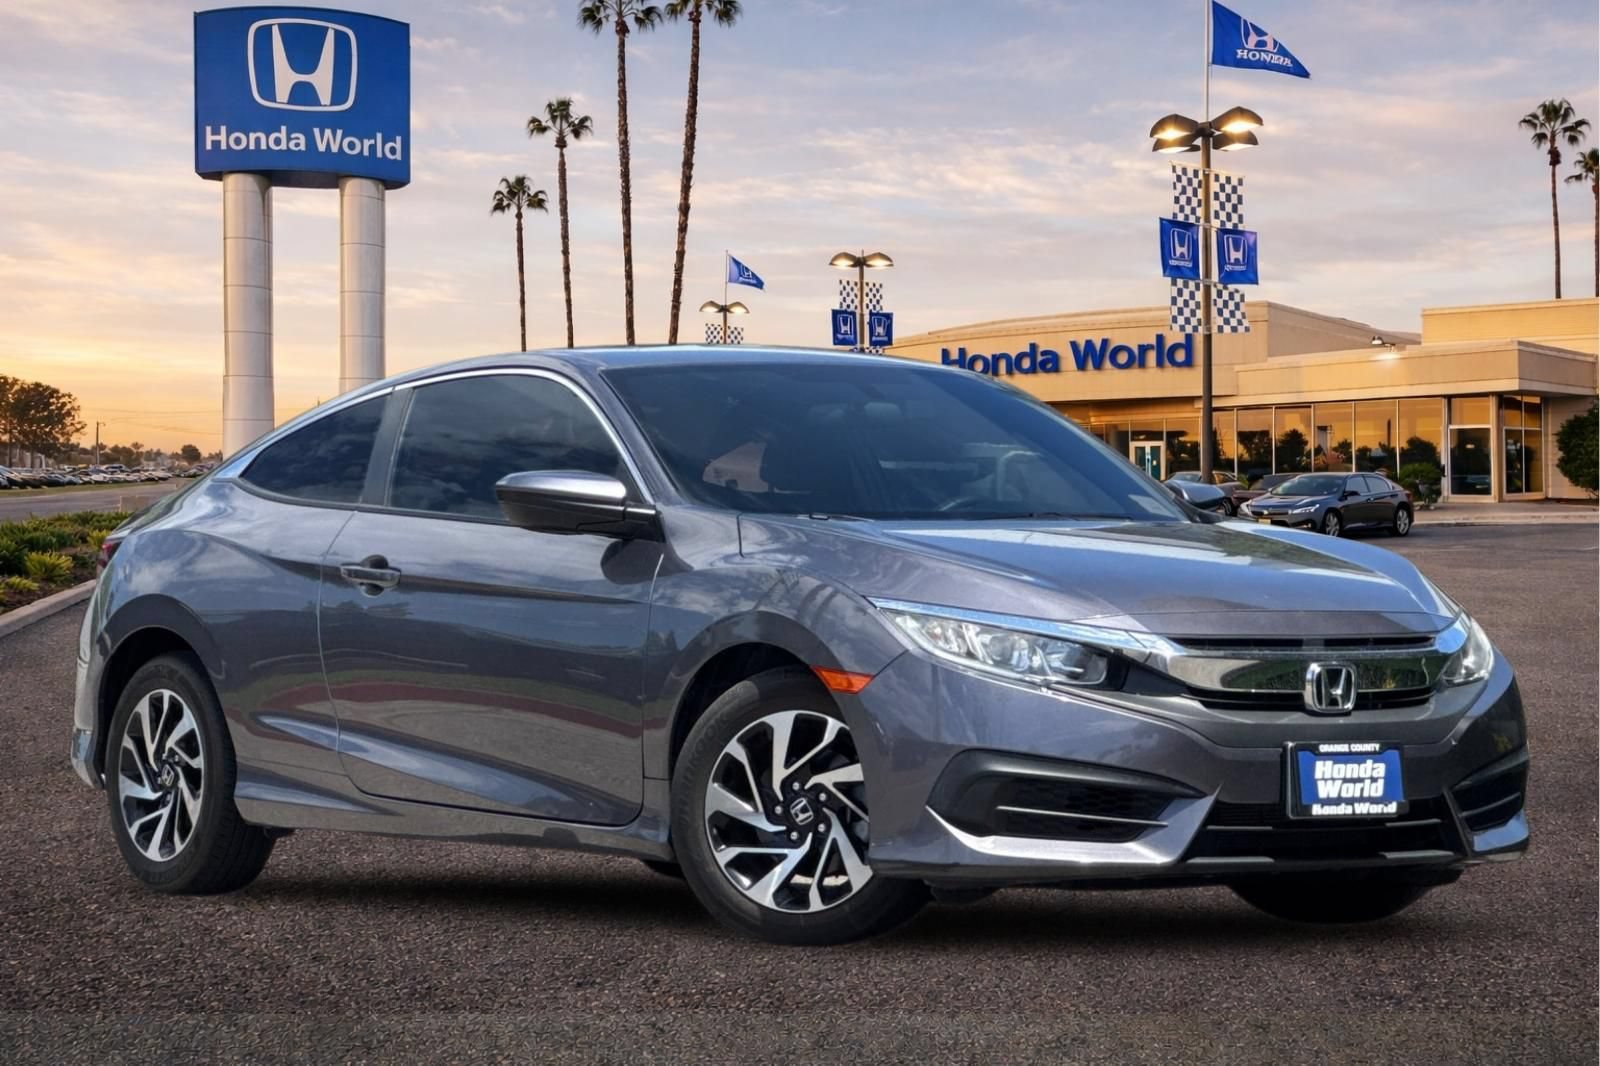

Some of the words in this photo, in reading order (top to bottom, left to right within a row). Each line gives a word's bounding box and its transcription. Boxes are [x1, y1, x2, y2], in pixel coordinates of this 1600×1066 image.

[205, 125, 306, 151] Honda
[312, 127, 402, 161] World
[941, 342, 1062, 376] Honda
[1069, 333, 1195, 371] World
[1350, 743, 1380, 752] COUNTY
[1314, 759, 1386, 779] Honda
[1317, 778, 1384, 798] World
[1312, 803, 1353, 815] Honda
[1353, 801, 1397, 814] World
